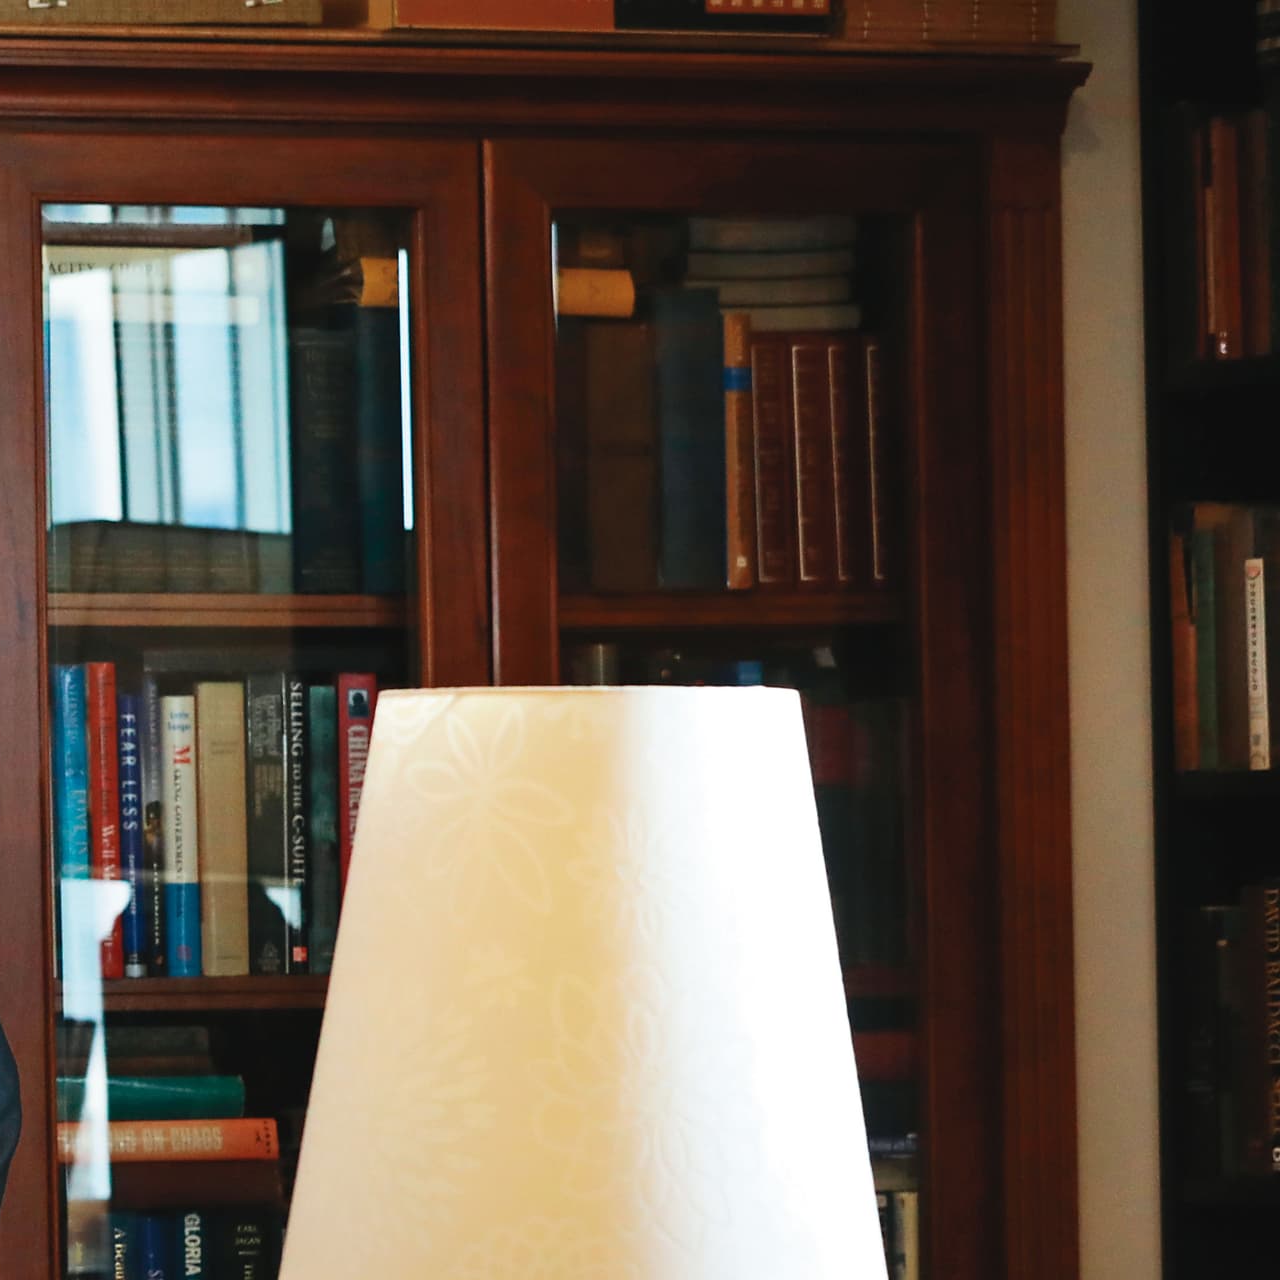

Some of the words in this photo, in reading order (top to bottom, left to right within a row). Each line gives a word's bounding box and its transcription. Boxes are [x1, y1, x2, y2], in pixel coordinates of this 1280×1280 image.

[121, 712, 136, 766] FEAR
[289, 681, 304, 758] SELLING
[123, 781, 138, 831] LESS
[290, 813, 306, 886] C-SUITE
[184, 1213, 201, 1277] GLORIA
